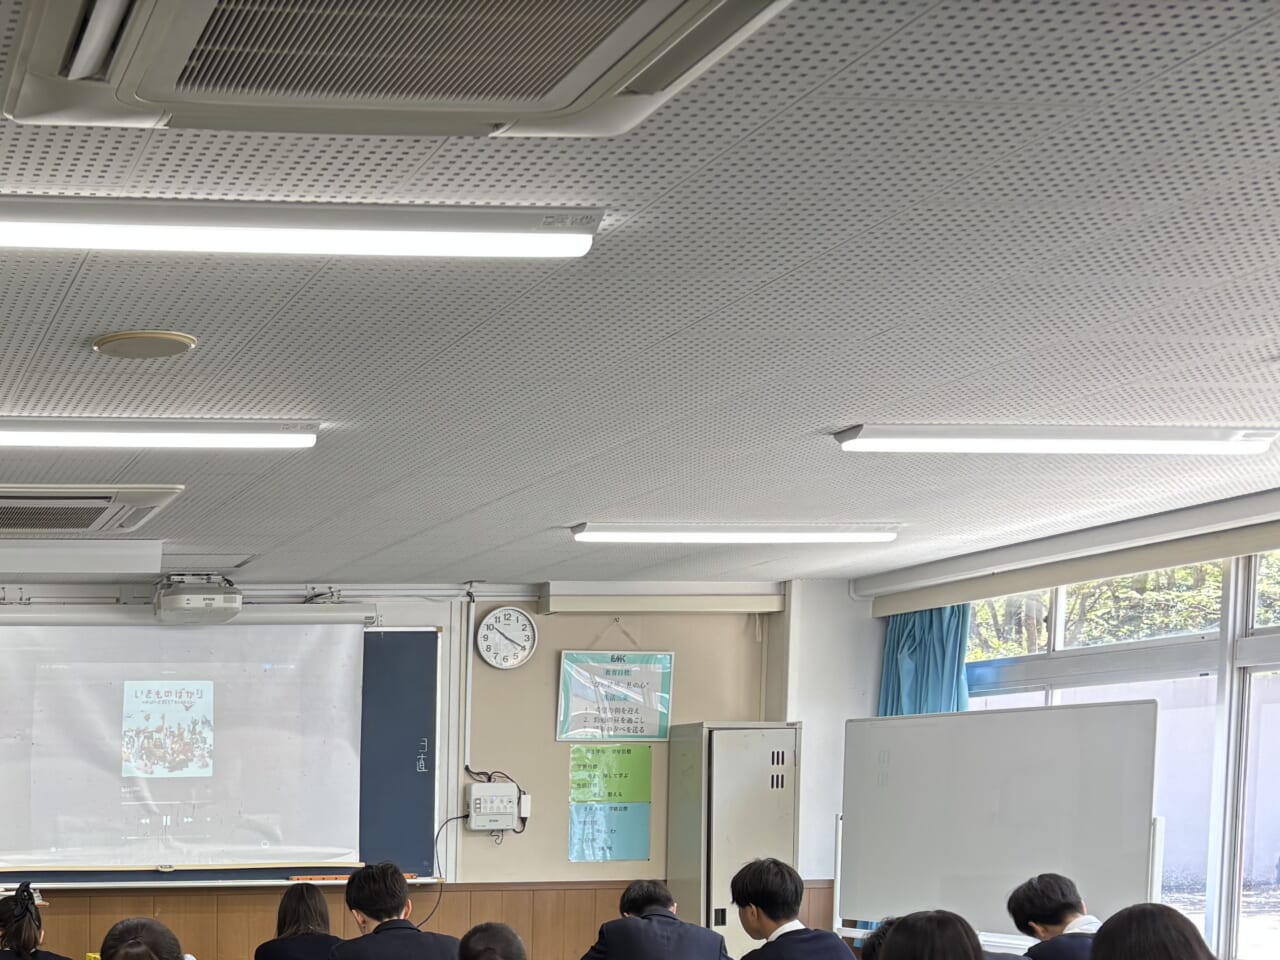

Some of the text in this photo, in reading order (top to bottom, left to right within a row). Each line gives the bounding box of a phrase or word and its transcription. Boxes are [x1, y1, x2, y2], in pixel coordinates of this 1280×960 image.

[494, 616, 501, 624] 11
[503, 613, 512, 621] 12
[486, 623, 495, 631] 10
[521, 623, 528, 632] 2
[482, 634, 489, 642] 9
[524, 634, 530, 642] 3
[485, 644, 492, 653] 8
[493, 652, 499, 660] 7
[502, 655, 509, 663] 6
[513, 652, 519, 660] 5
